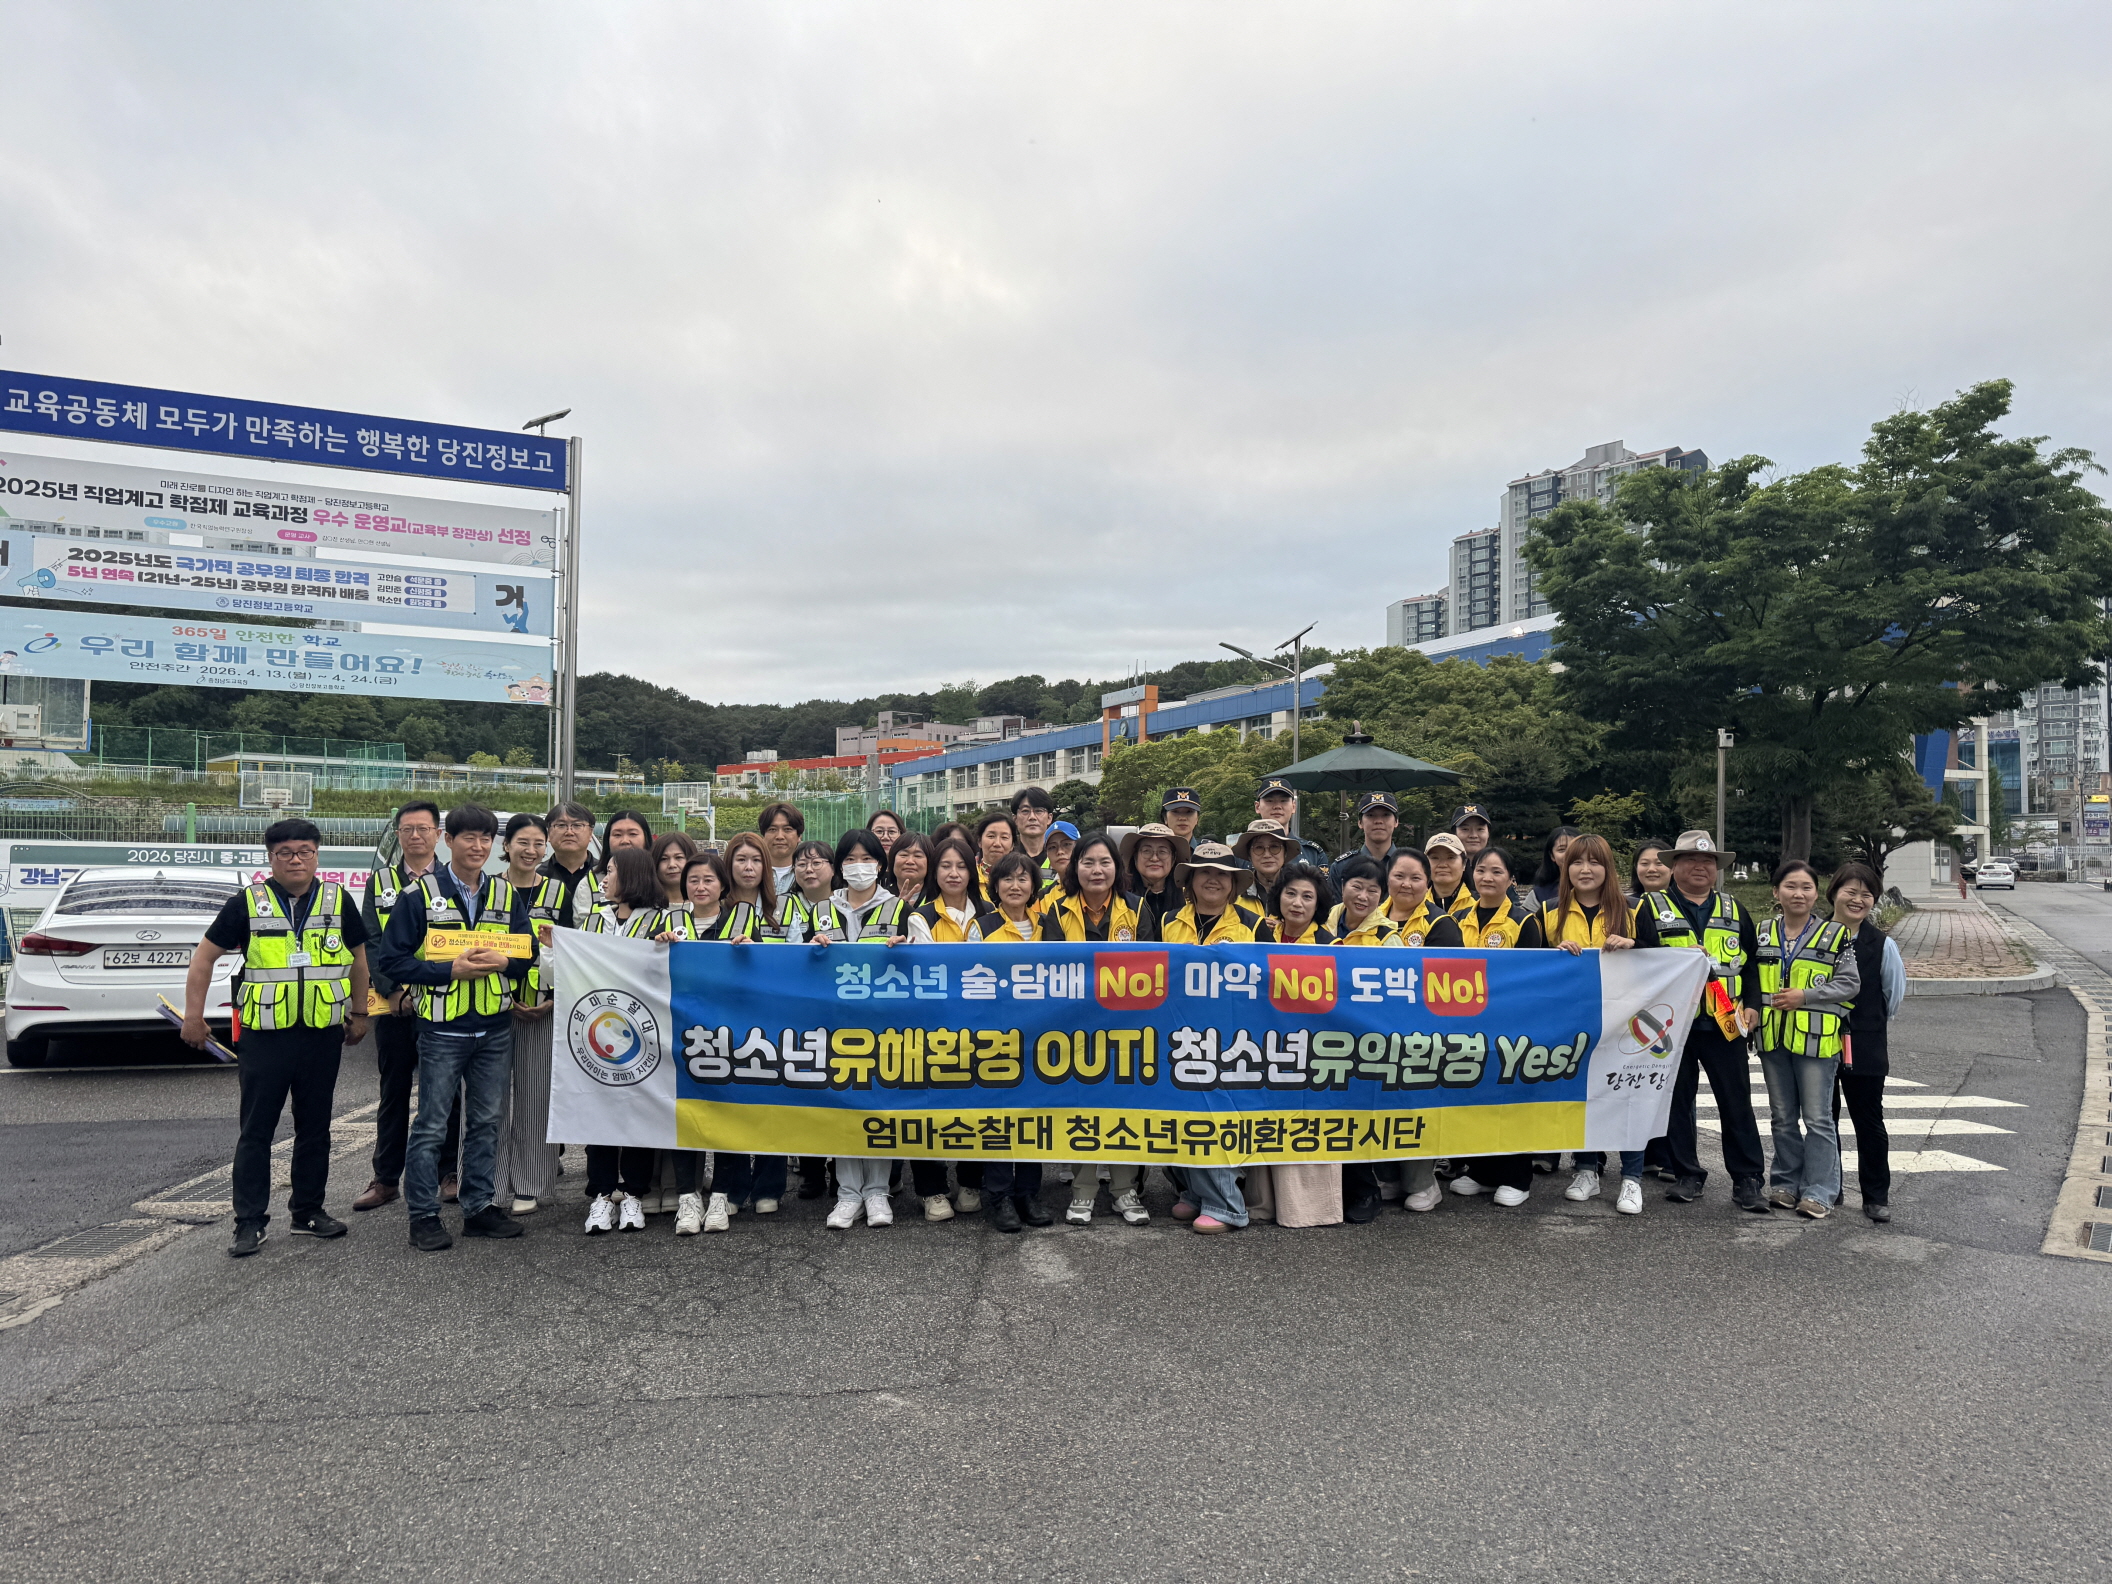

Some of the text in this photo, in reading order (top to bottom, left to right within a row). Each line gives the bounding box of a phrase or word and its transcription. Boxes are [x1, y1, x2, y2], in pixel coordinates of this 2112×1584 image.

[3, 388, 554, 473] 교육공동체 모두가 만족하는 행복한 당진정보고
[160, 480, 178, 490] 미래
[208, 485, 234, 496] 디자인
[236, 488, 253, 497] 하는
[255, 490, 289, 502] 직업계고
[291, 494, 315, 504] 학점제
[325, 497, 389, 512] 당진정보고등학교
[84, 485, 163, 509] 직업계고
[170, 494, 227, 516] 학점제
[233, 501, 308, 524] 교육과정
[313, 509, 349, 528] 우수
[354, 513, 448, 538] 운영교(교육부
[452, 527, 493, 542] 장관상)
[498, 528, 531, 546] 선정
[67, 547, 370, 586] 2025년도 국가직 공무원 최종 합격
[67, 565, 370, 601] 5년 연속 (21년~25년) 공무원 합격자 배출
[232, 599, 313, 613] 당진정보고등학교
[172, 626, 342, 647] 365일 안전한 학교
[80, 635, 154, 659] 우리
[174, 642, 247, 664] 함께
[266, 648, 423, 675] 만들어요!
[129, 661, 190, 673] 안전주간
[200, 665, 241, 676] 2026.
[247, 669, 261, 677] 4.
[266, 670, 312, 680] 13.(월)
[332, 674, 345, 682] 4.
[351, 675, 397, 685] 24.(금)
[127, 850, 171, 863] 2026
[174, 850, 214, 864] 당진시
[349, 872, 372, 888] 신
[112, 952, 183, 964] 62보 4227
[835, 961, 1486, 1006] 청소년 술·담배 No! 마약 No! 도박 No!
[577, 1047, 656, 1081] 우리아이는 엄마가 지킨다
[684, 1024, 1023, 1087] 청소년유해환경
[1035, 1026, 1157, 1085] OUT!
[1497, 1031, 1589, 1084] Yes!
[1606, 1072, 1670, 1091] 당찬 당
[862, 1115, 1426, 1156] 엄마순찰대 청소년유해환경감시단
